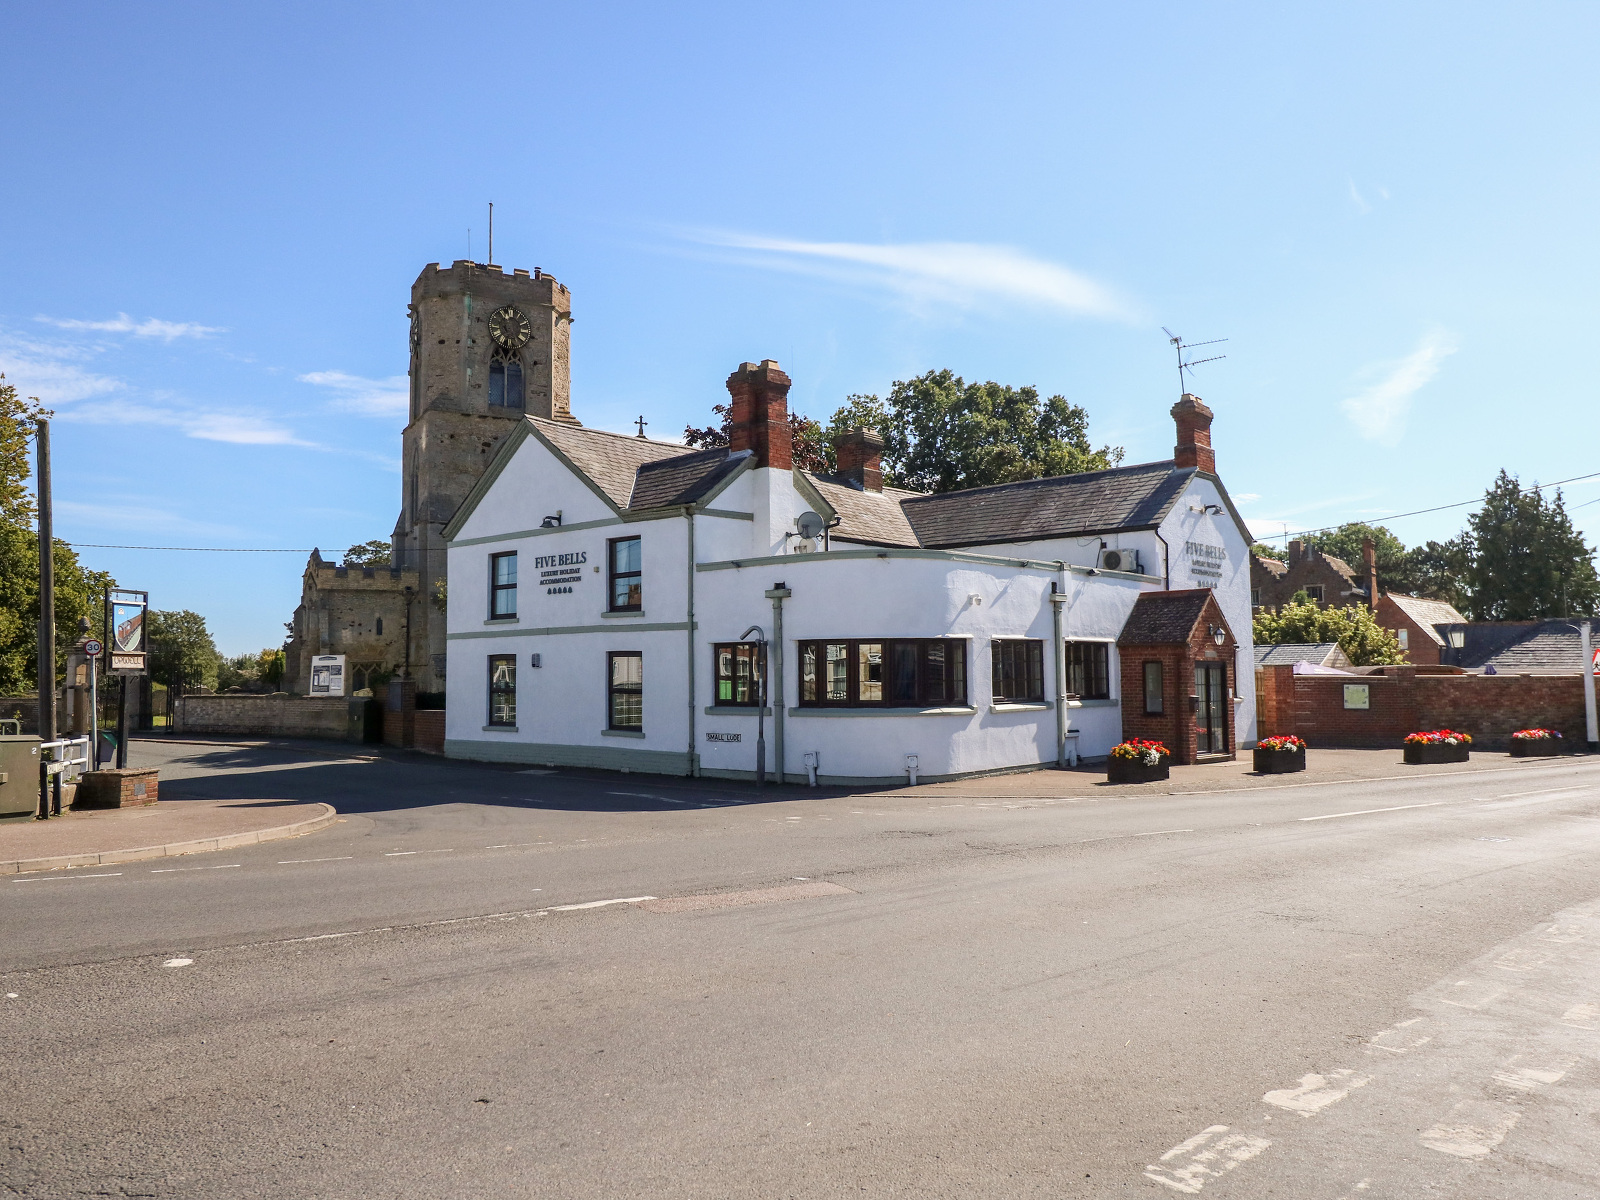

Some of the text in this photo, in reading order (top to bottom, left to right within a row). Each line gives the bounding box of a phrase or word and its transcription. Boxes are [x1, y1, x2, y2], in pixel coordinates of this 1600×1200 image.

[1185, 541, 1204, 556] FIVE
[535, 552, 586, 568] FIVE BELLS
[539, 576, 581, 585] ACCOMMODATION
[87, 643, 100, 651] 30
[114, 656, 141, 665] UPWELL
